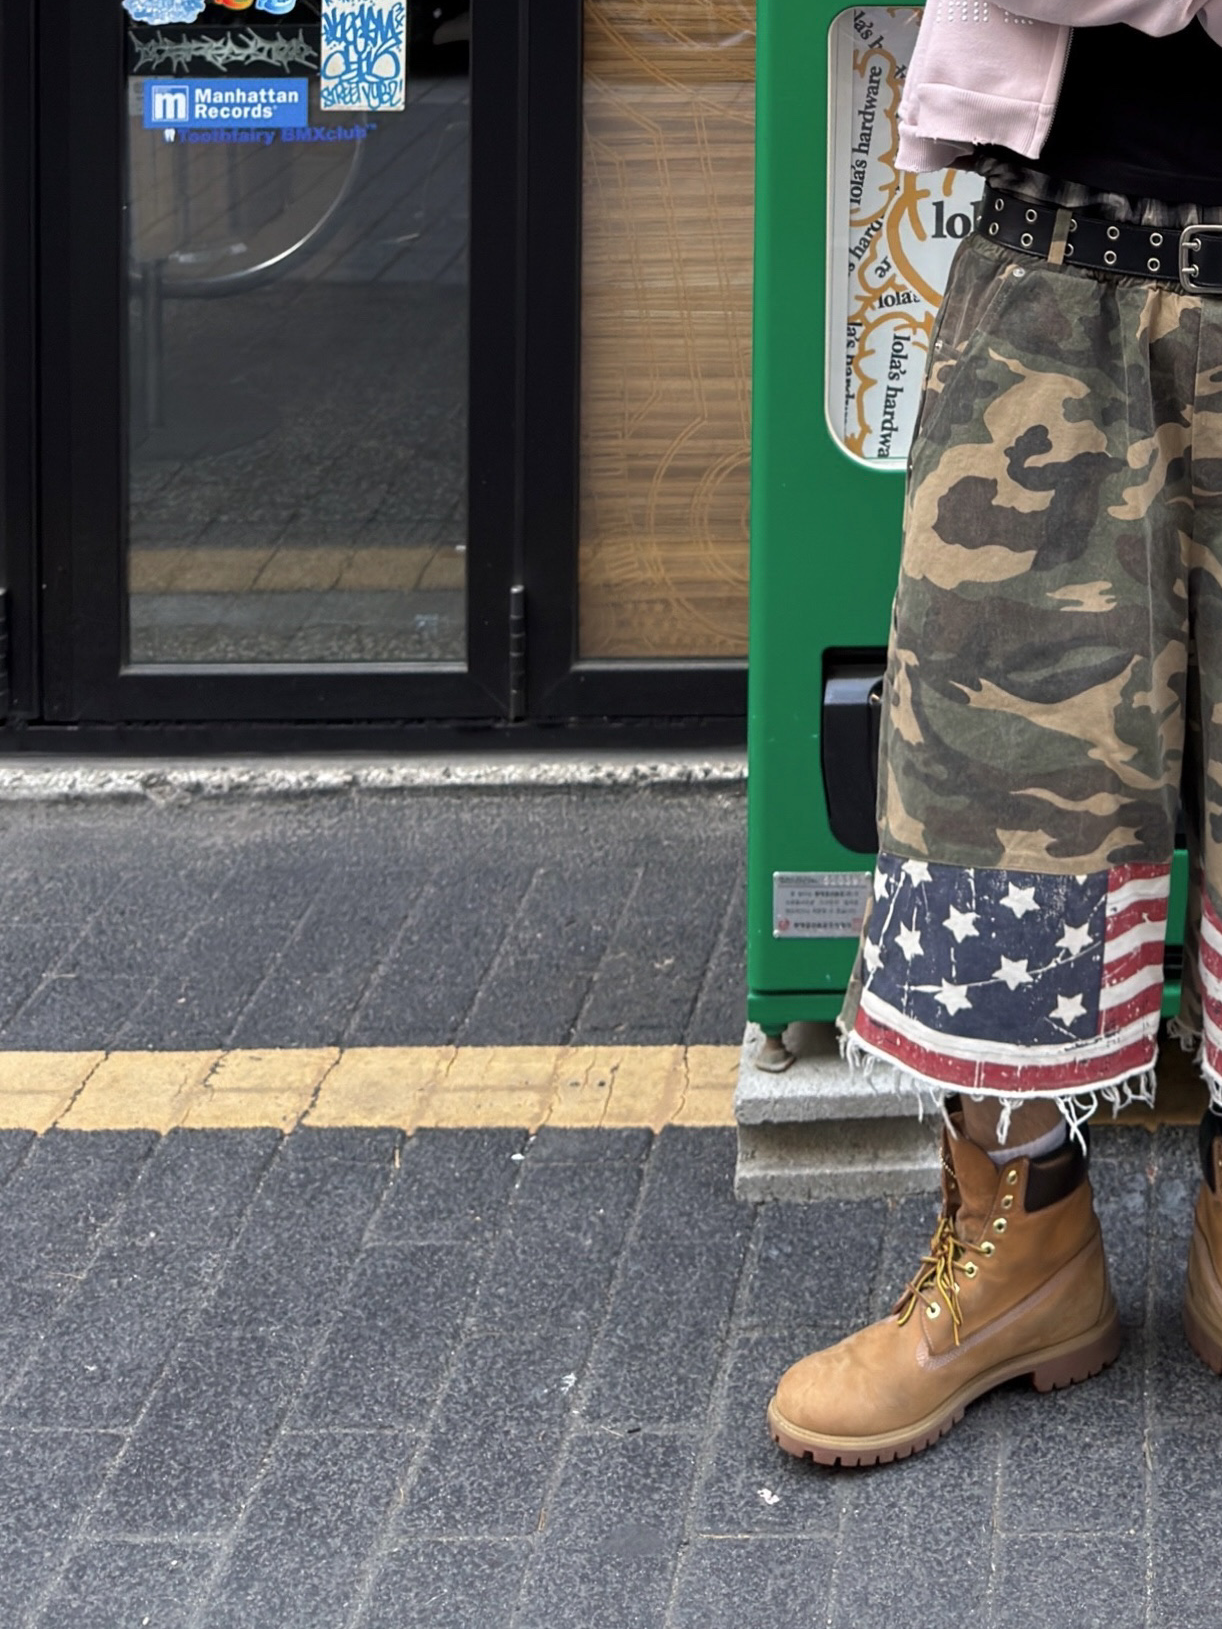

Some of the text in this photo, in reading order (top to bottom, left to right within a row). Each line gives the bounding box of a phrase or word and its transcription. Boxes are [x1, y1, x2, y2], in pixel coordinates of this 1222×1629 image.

[195, 88, 299, 103] Manhattan
[195, 104, 273, 118] Records
[857, 66, 882, 155] hardware
